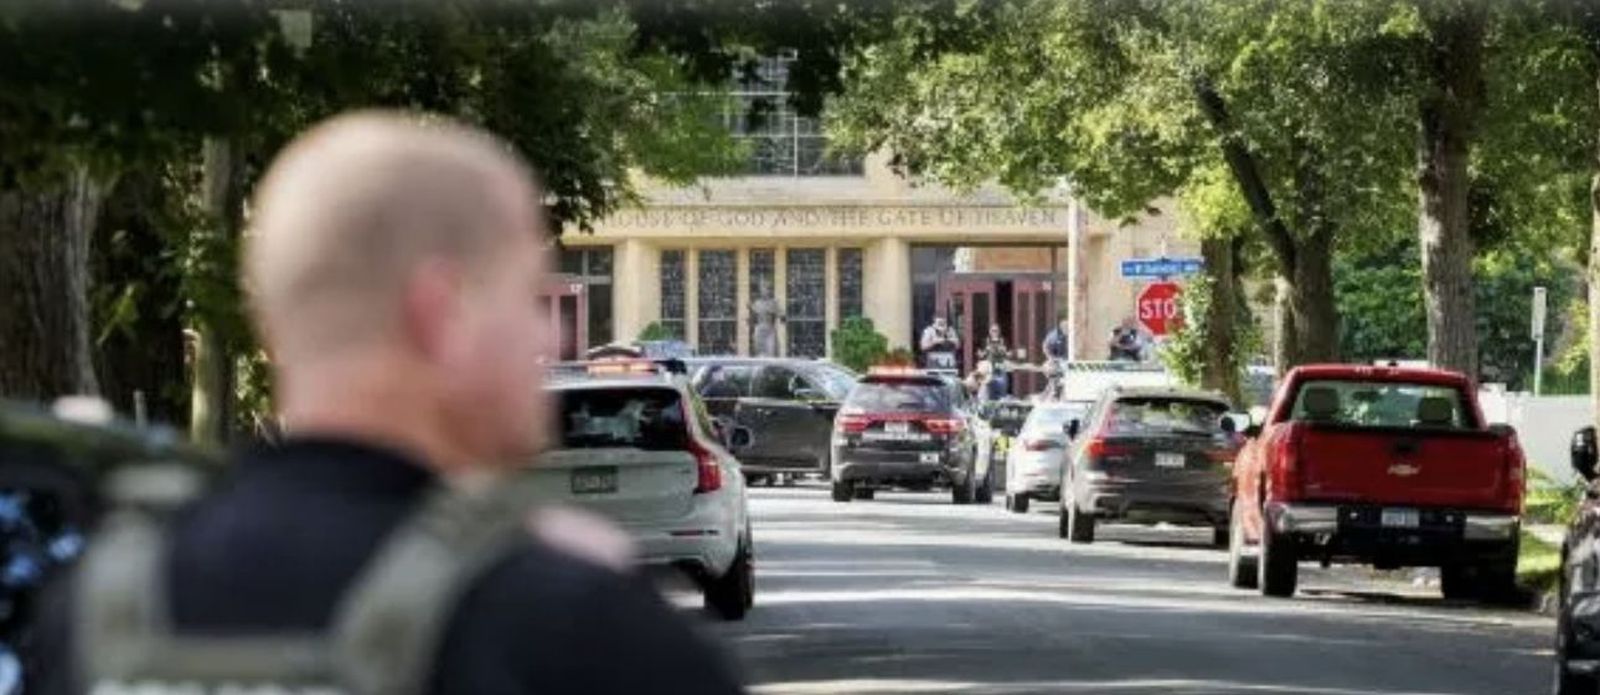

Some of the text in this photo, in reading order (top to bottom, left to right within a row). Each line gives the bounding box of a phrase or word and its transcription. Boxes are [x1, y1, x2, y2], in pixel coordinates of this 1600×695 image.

[719, 209, 765, 226] GOD
[772, 209, 821, 226] AND
[830, 209, 869, 226] THE
[876, 209, 931, 226] GATE
[1140, 298, 1177, 319] STO
